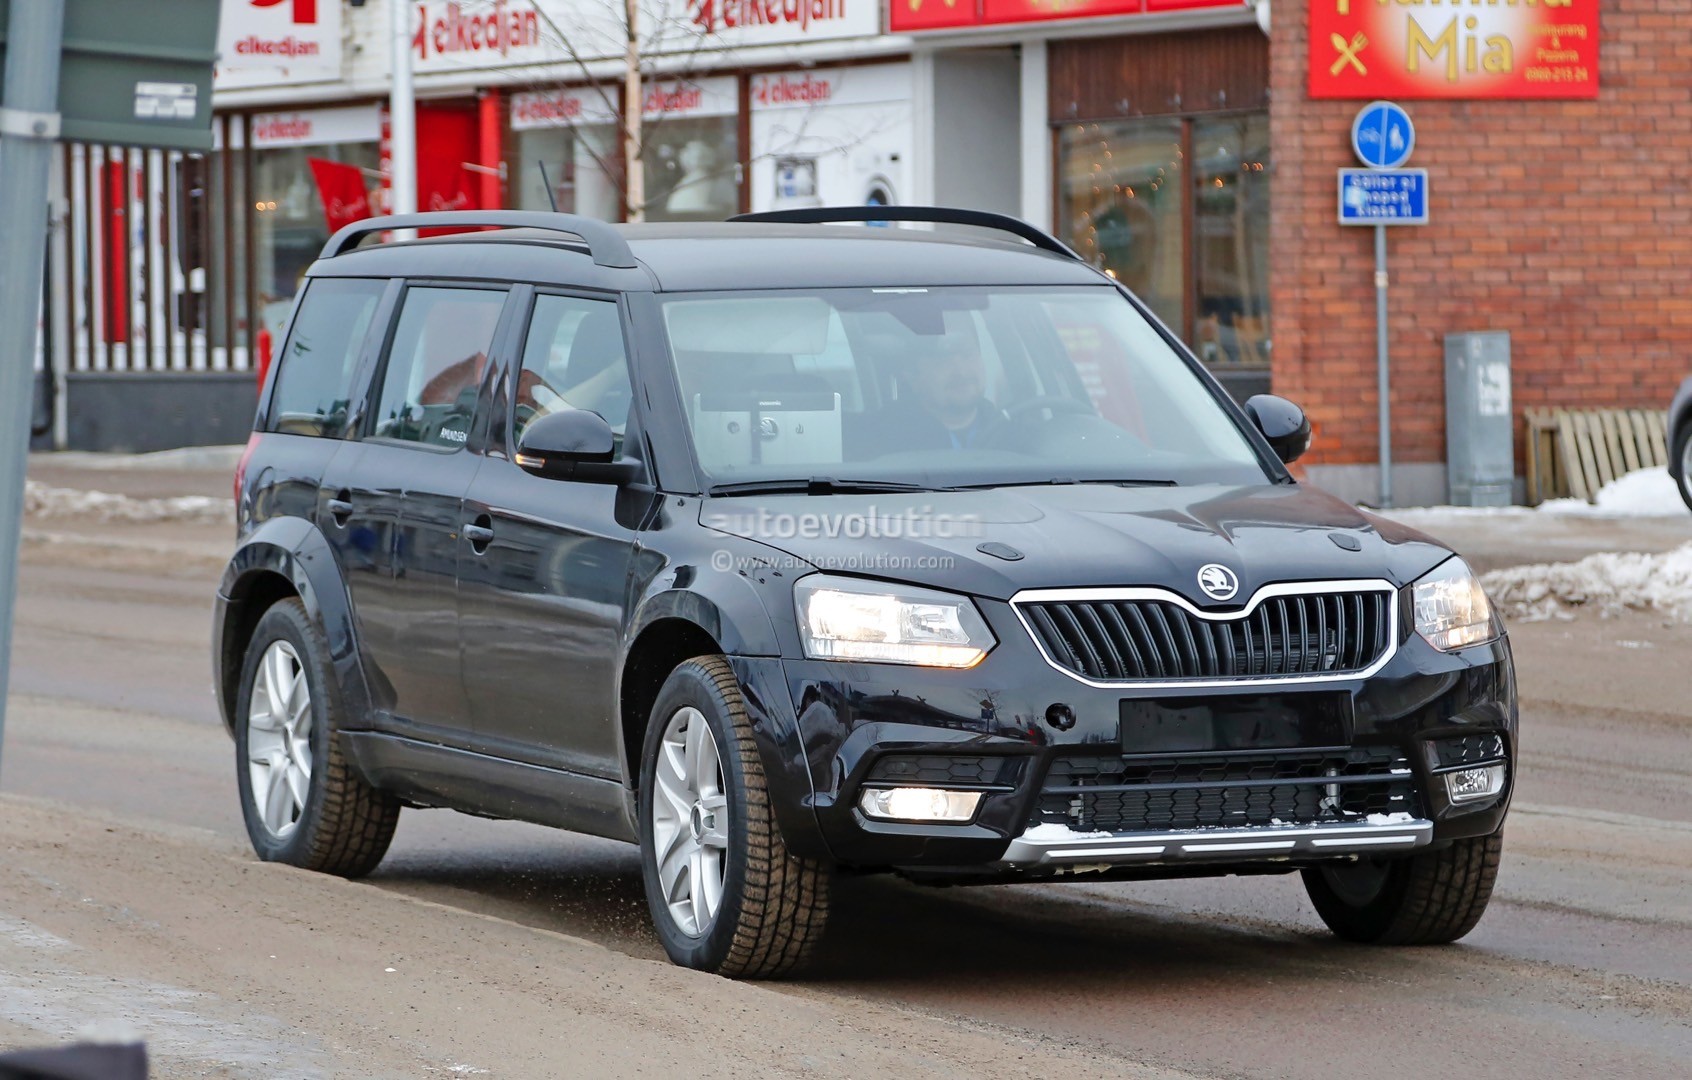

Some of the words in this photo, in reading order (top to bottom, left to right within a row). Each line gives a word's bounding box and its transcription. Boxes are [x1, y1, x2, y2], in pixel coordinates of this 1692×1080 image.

[235, 36, 318, 57] elkedjan
[433, 0, 538, 57] elkedjan
[1407, 14, 1513, 81] Mia
